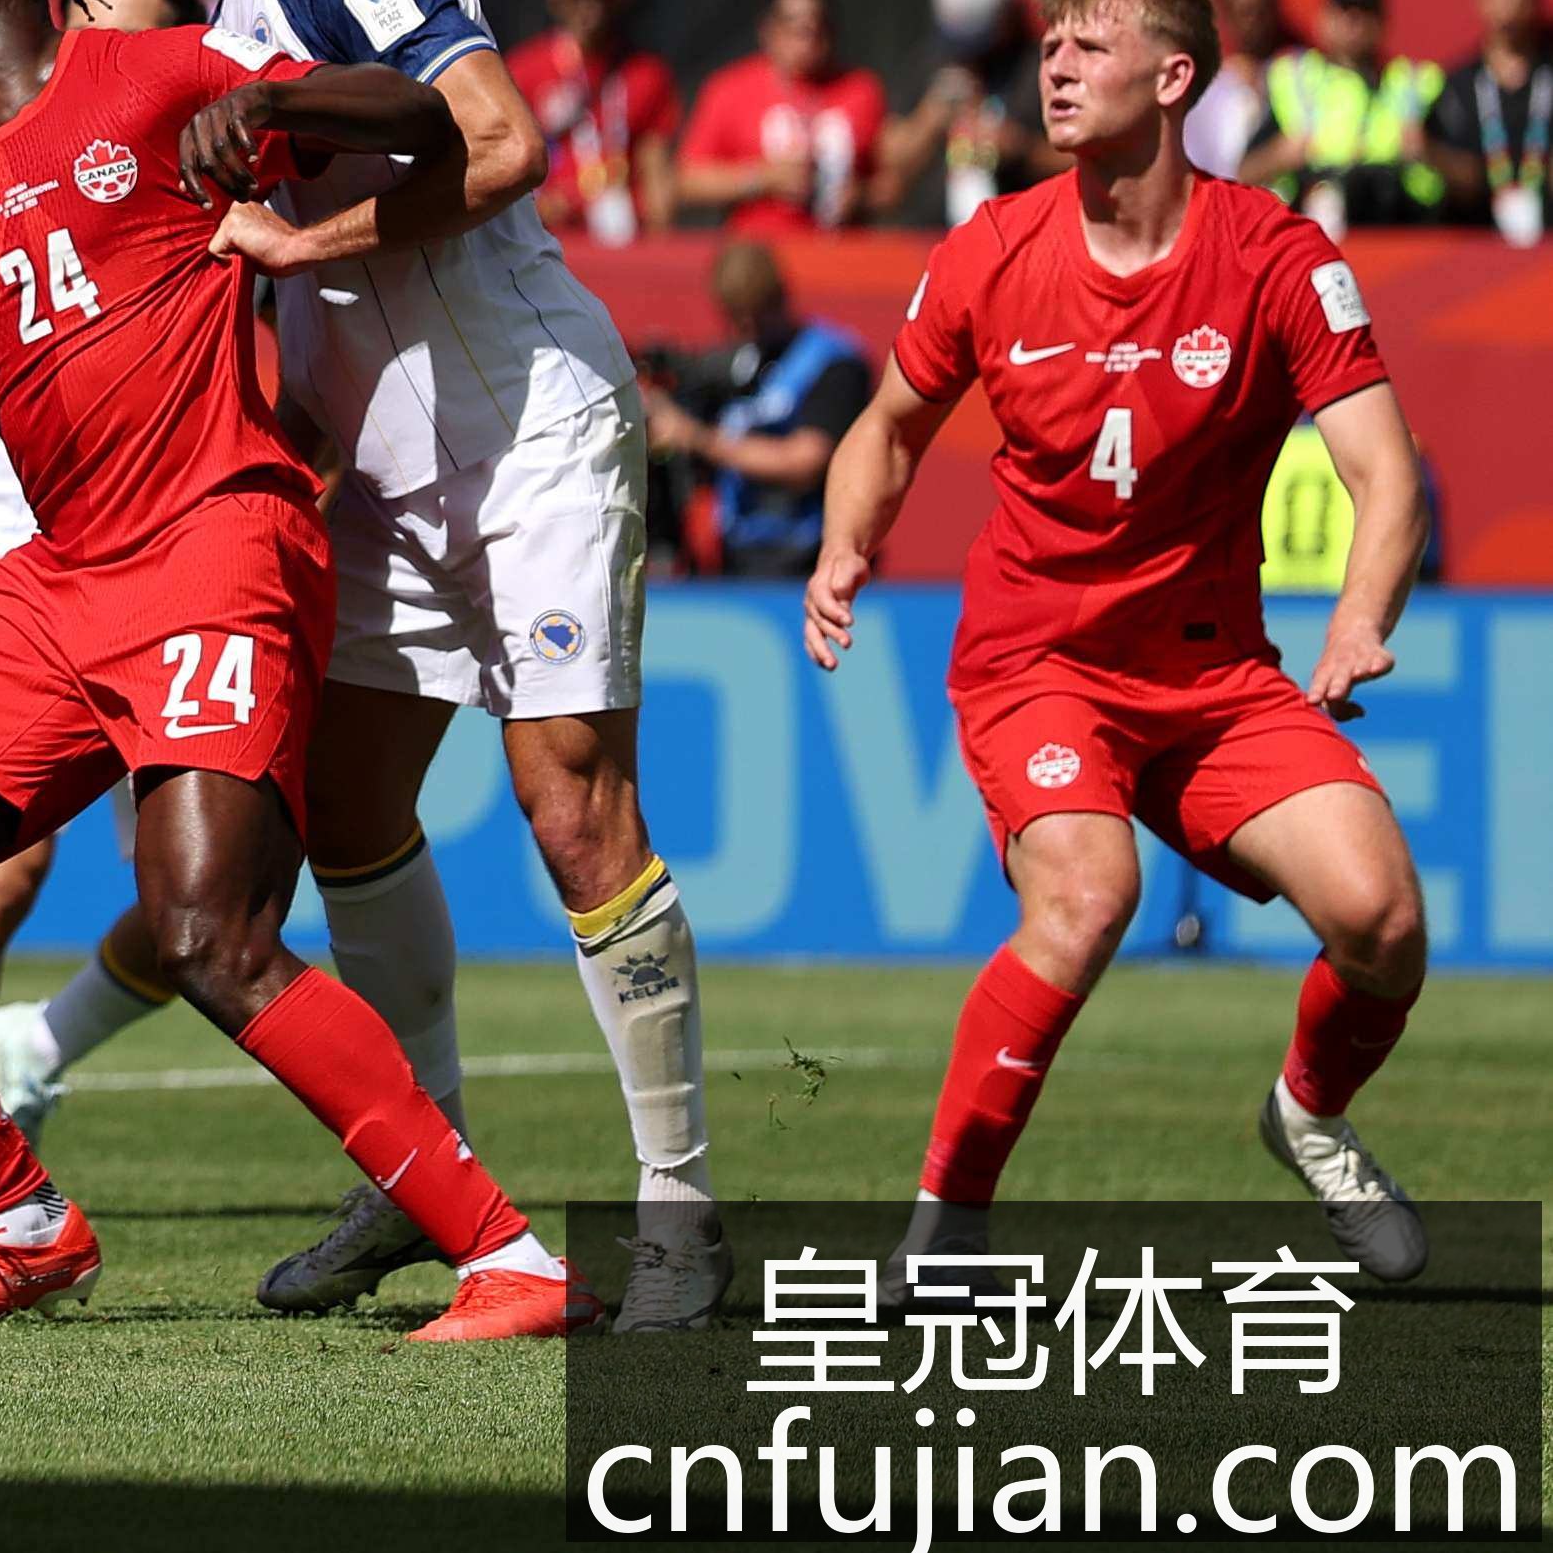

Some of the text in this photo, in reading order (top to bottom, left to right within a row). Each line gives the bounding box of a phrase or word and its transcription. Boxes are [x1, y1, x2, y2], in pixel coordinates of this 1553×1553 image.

[77, 161, 136, 183] CANADA
[1090, 408, 1137, 499] 4
[160, 633, 256, 725] 24
